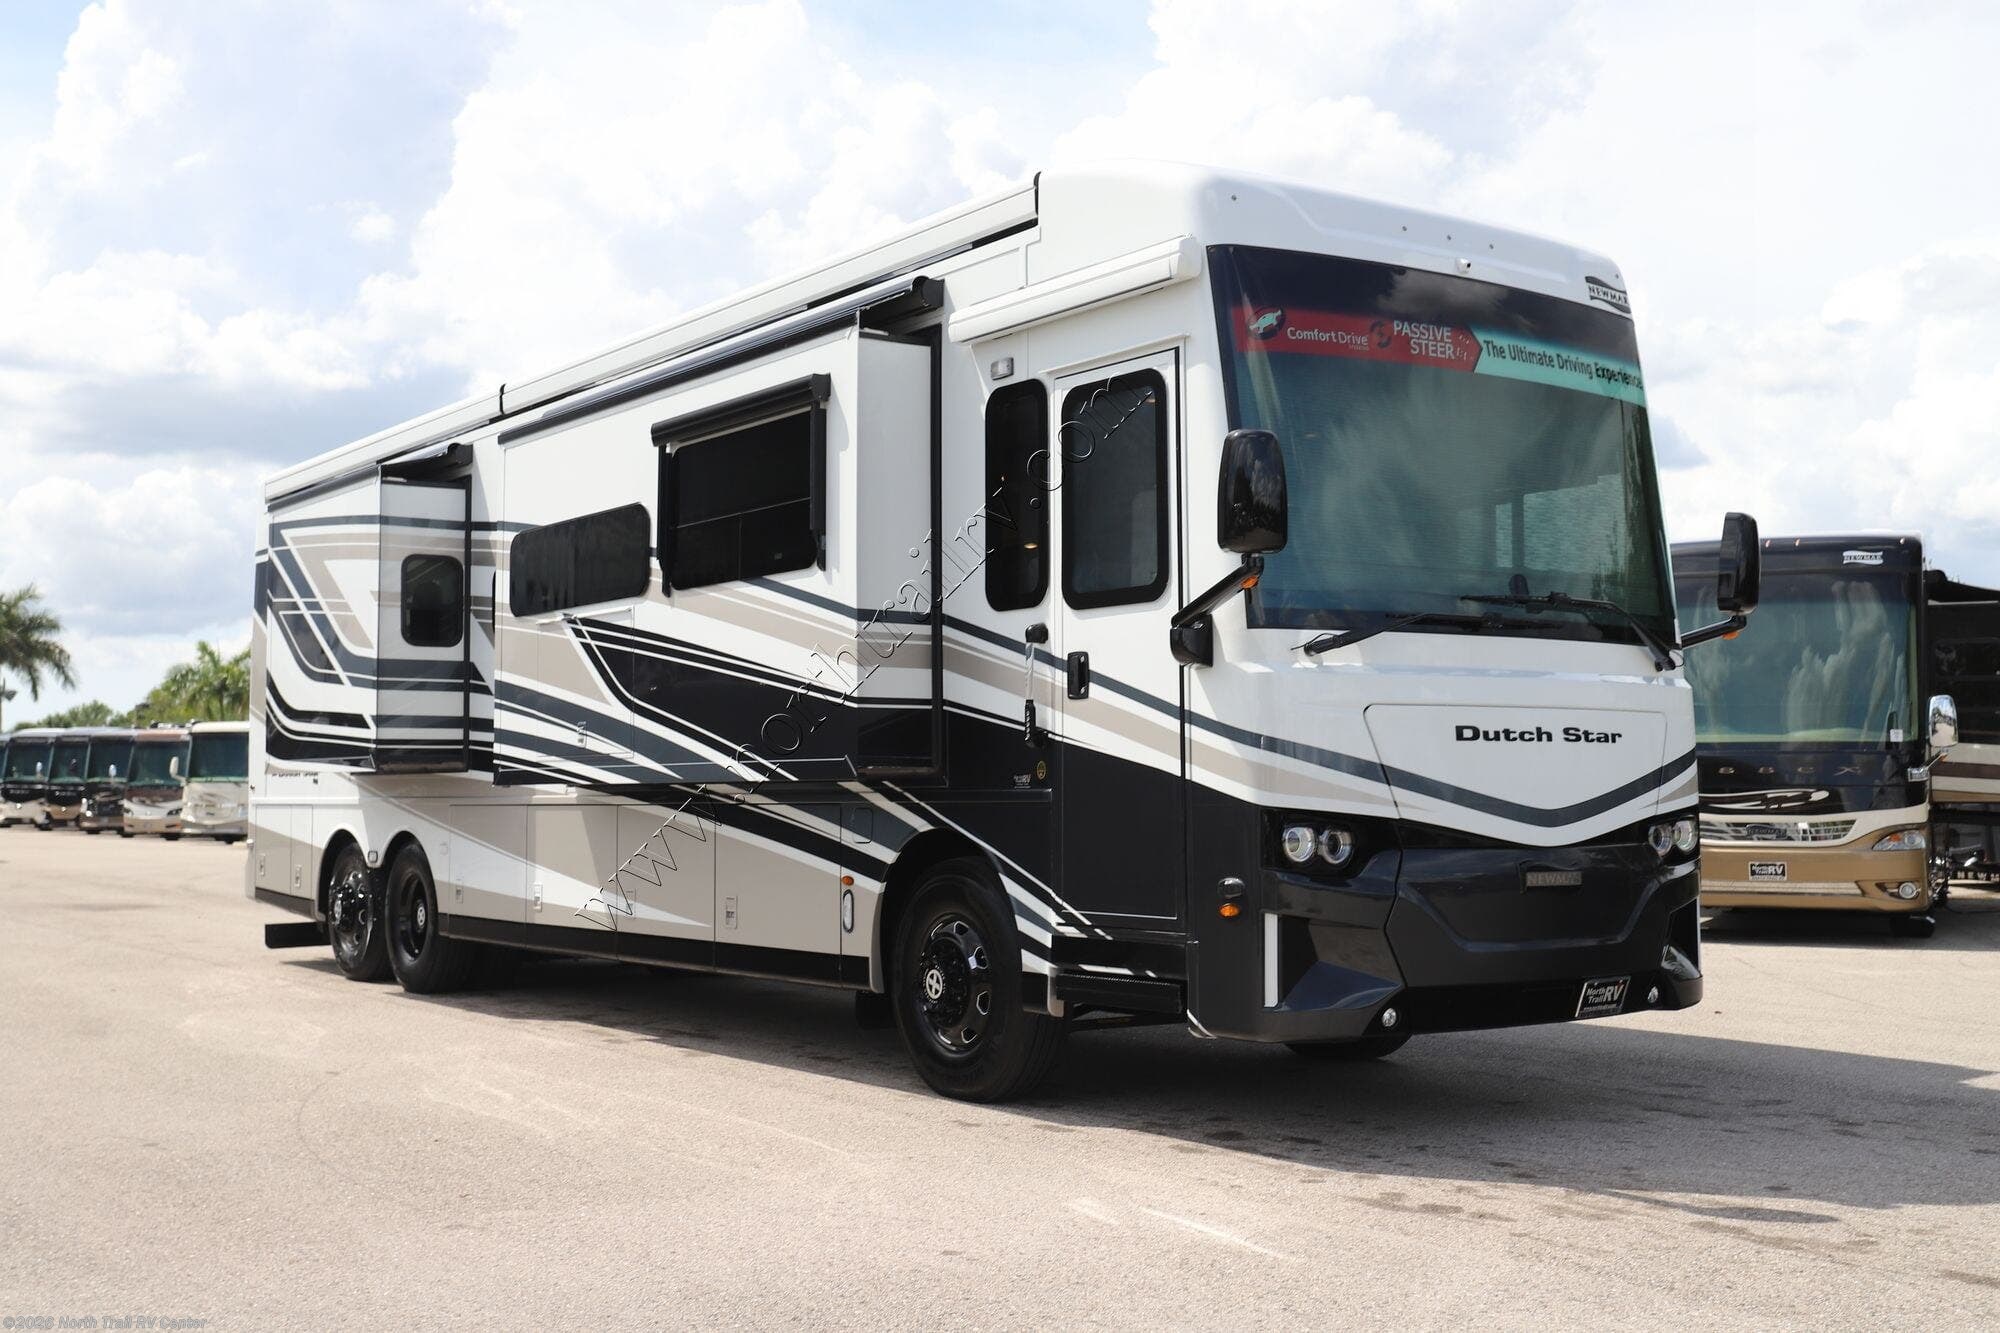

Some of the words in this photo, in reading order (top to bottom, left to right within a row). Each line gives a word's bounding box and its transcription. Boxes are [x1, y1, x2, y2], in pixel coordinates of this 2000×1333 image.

[1286, 326, 1338, 344] Comfort
[1338, 331, 1369, 347] Drive
[1393, 320, 1452, 343] PASSIVE
[1410, 338, 1456, 360] STEER
[1483, 339, 1507, 360] The
[1507, 343, 1555, 369] Ultimate
[1556, 353, 1593, 380] Driving
[1455, 725, 1553, 743] Dutch
[1562, 726, 1623, 744] Star
[1768, 864, 1784, 875] RV
[1602, 985, 1624, 1002] RV
